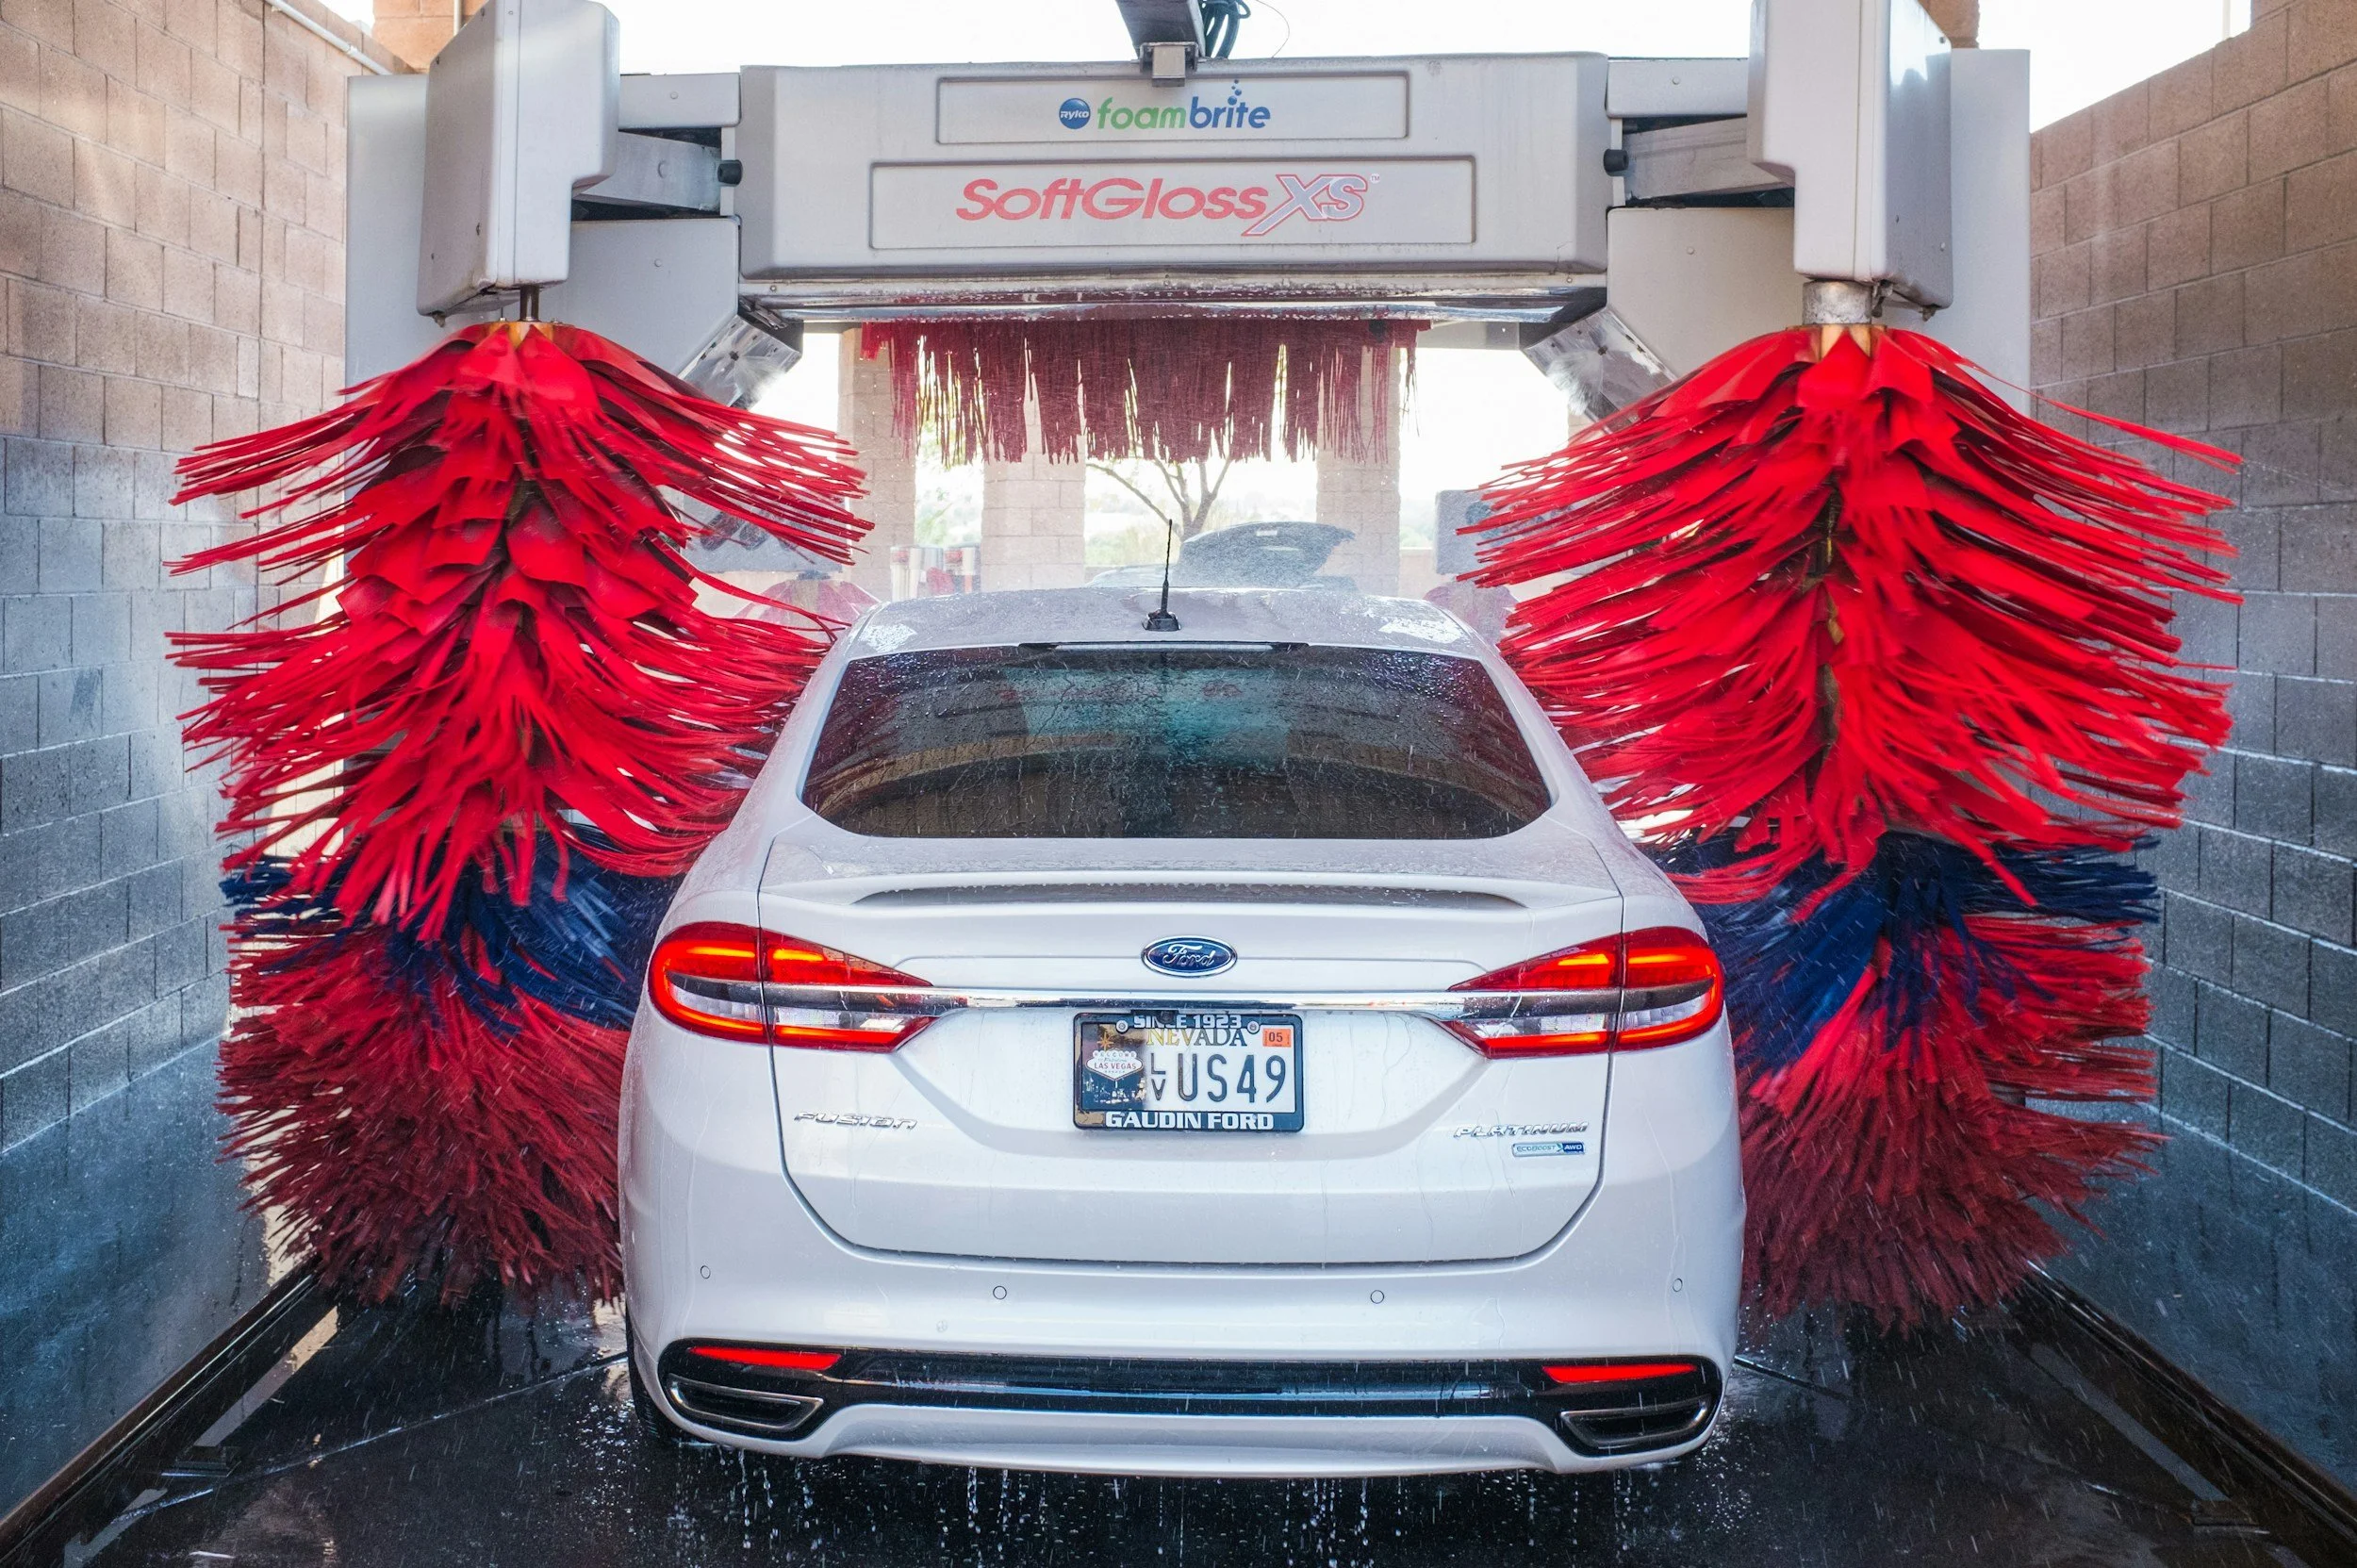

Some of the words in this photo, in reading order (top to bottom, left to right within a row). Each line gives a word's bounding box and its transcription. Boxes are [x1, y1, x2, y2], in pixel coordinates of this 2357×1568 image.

[1096, 96, 1271, 130] foambrite
[1162, 943, 1216, 967] Ford
[1193, 1015, 1242, 1029] 1923
[1146, 1028, 1248, 1047] NEVADA
[1268, 1032, 1283, 1043] 05
[1111, 1062, 1137, 1070] VEGAS
[793, 1112, 918, 1131] FUSION
[1105, 1111, 1203, 1130] GAUDIN
[1207, 1112, 1274, 1131] FORD
[1453, 1121, 1590, 1138] PLATINUM
